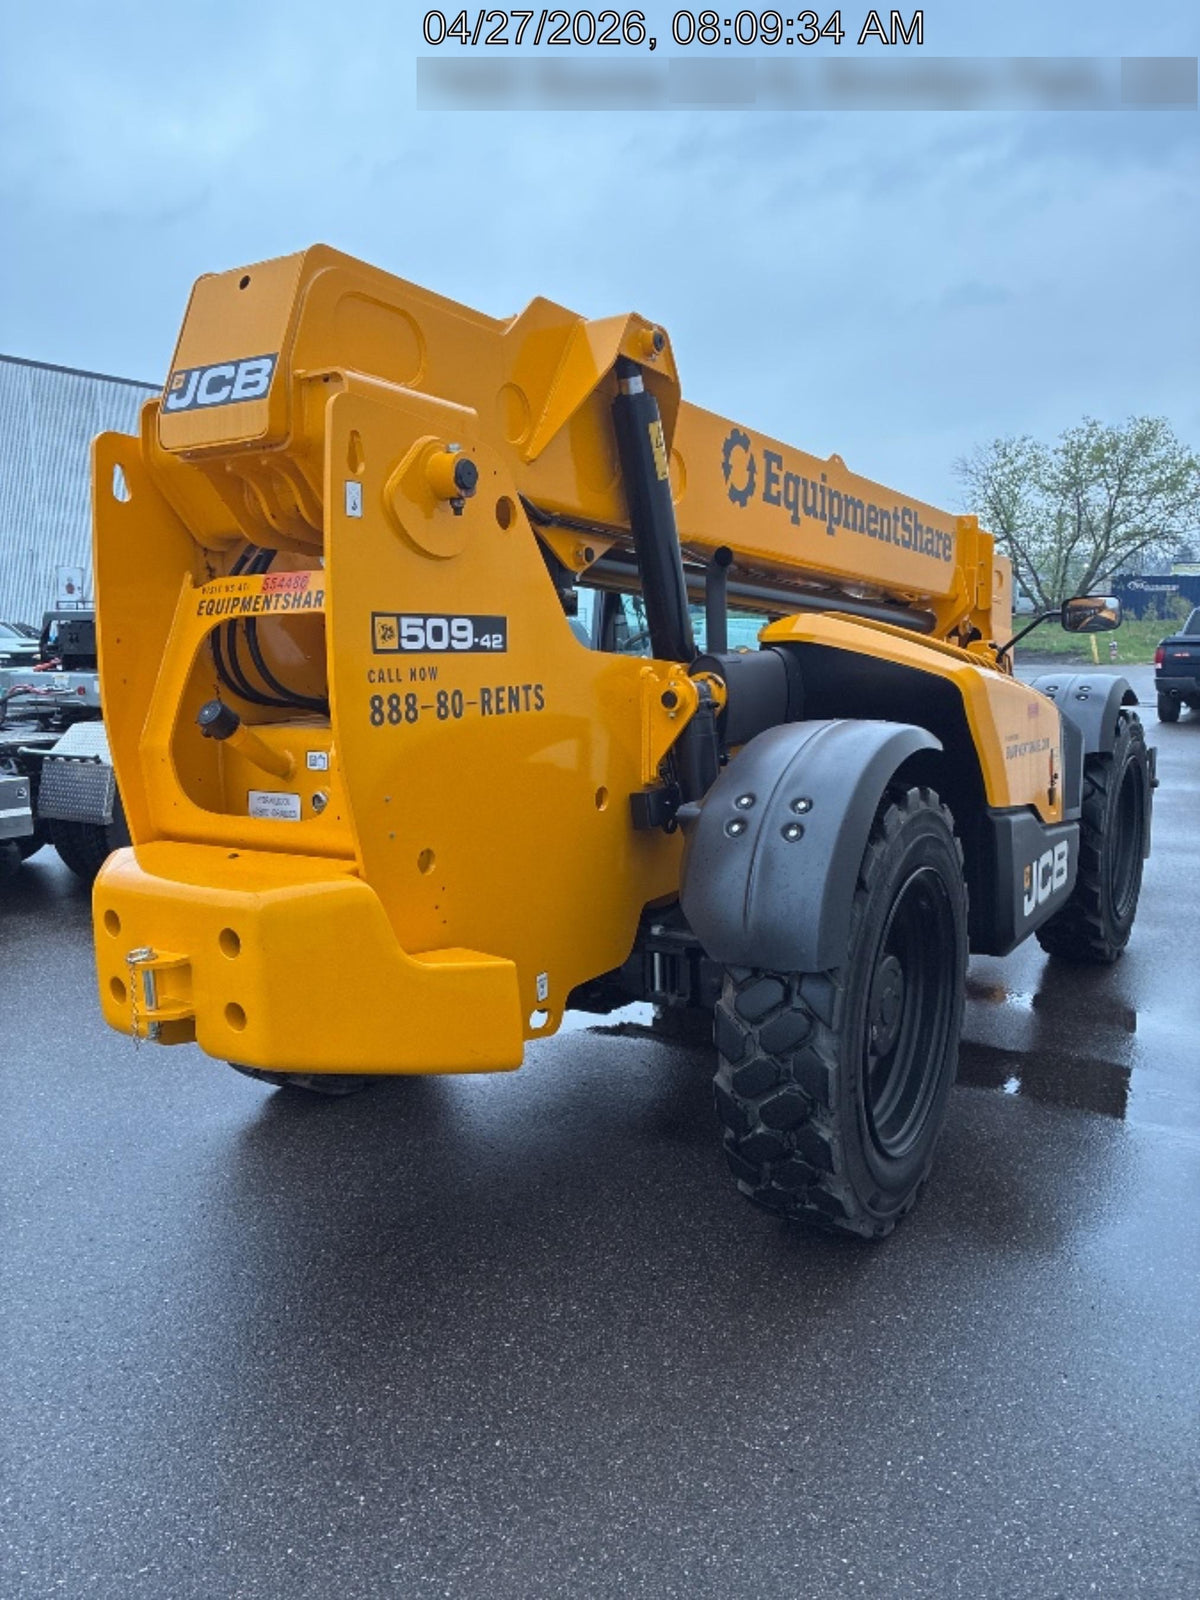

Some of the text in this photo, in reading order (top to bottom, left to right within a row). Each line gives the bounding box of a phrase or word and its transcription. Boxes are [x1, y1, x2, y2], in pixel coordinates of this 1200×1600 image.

[166, 358, 273, 410] JCB
[762, 449, 952, 562] EquipmentShare
[196, 590, 325, 616] EQUIPMENTSHAR
[367, 667, 438, 684] CALL NOW
[369, 684, 545, 727] 888-80-RENTS
[1023, 840, 1069, 917] JCB
